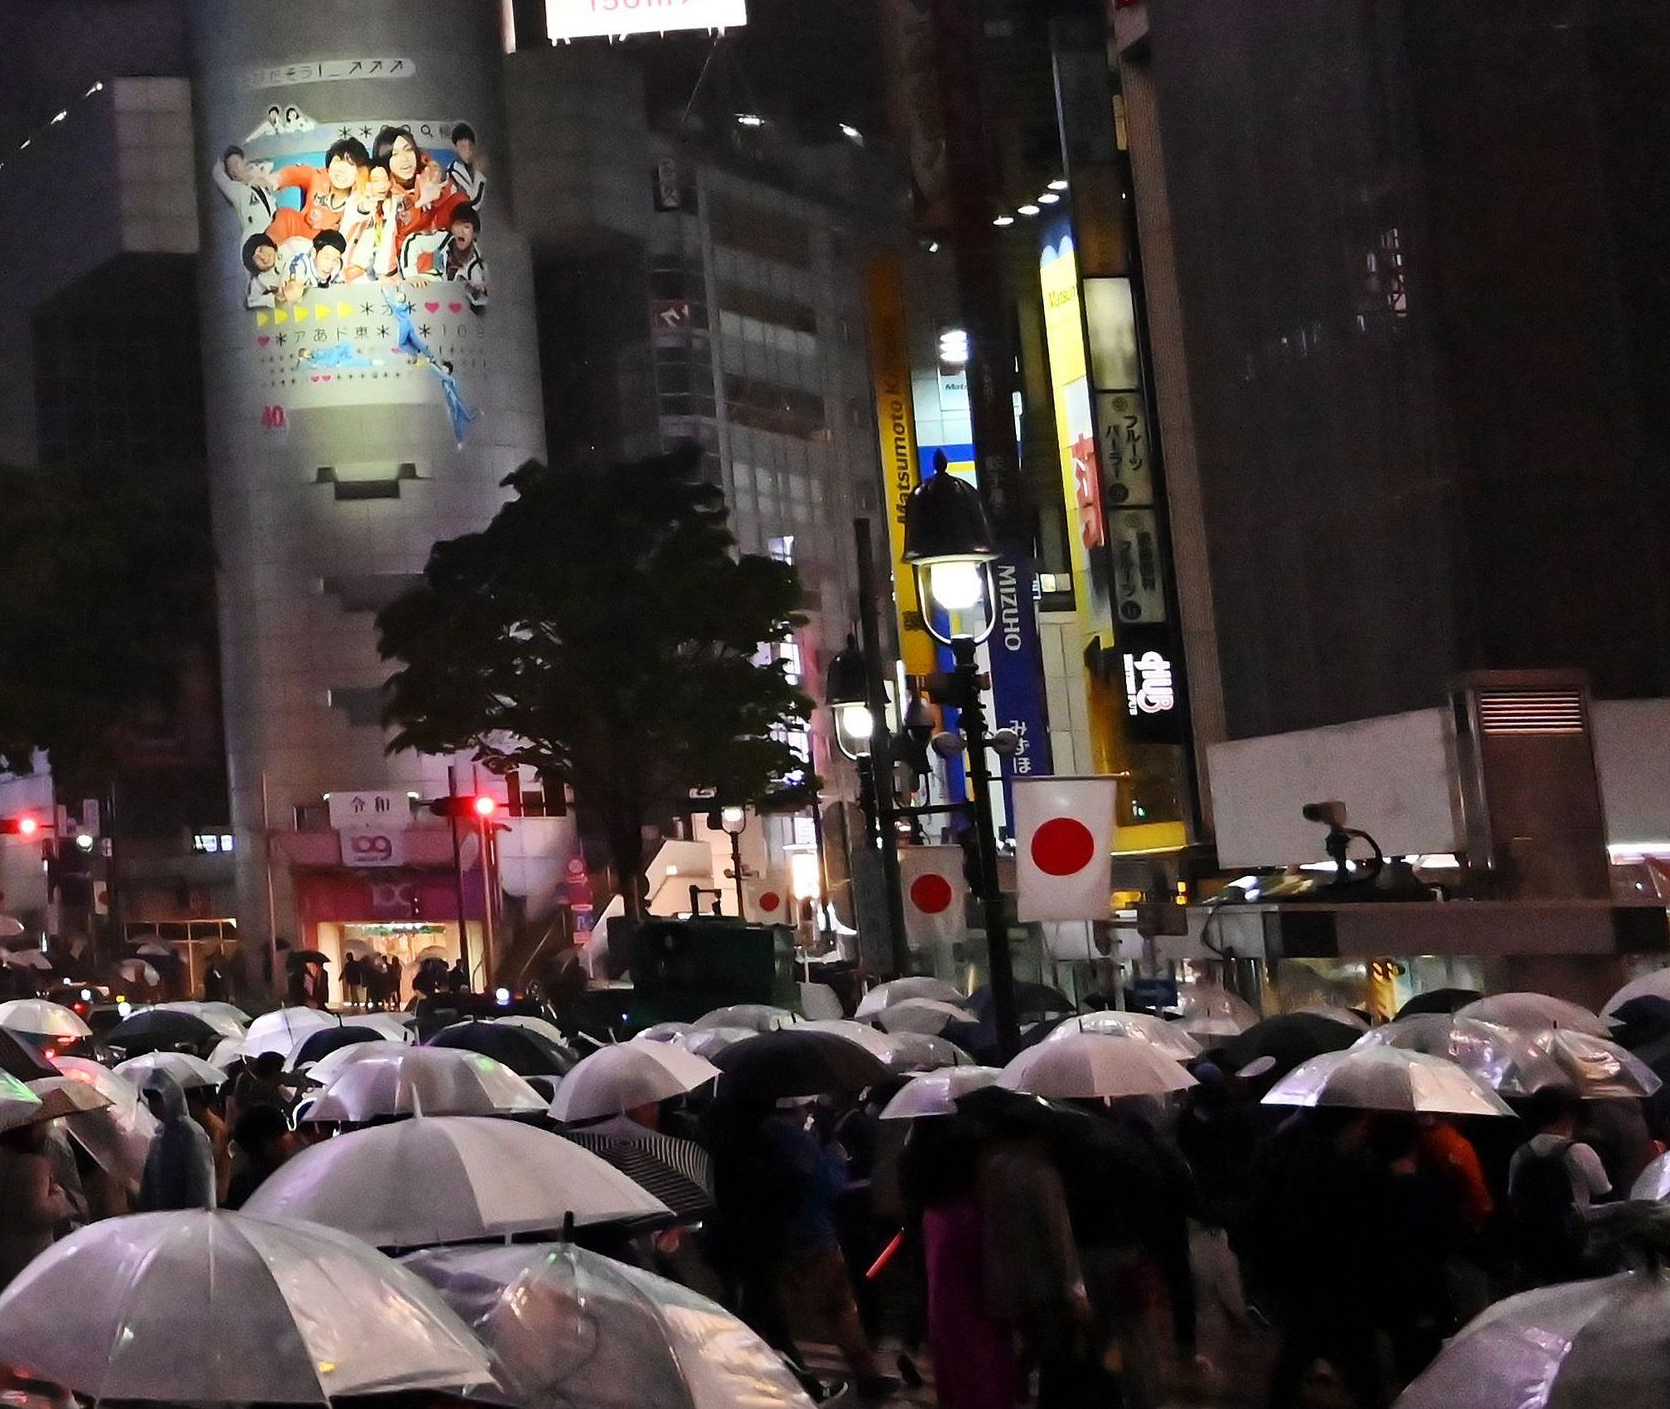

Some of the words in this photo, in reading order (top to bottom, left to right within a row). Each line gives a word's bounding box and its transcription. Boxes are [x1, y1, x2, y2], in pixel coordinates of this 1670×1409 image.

[1124, 414, 1143, 472] フルーツ
[998, 564, 1023, 652] MIZUHO
